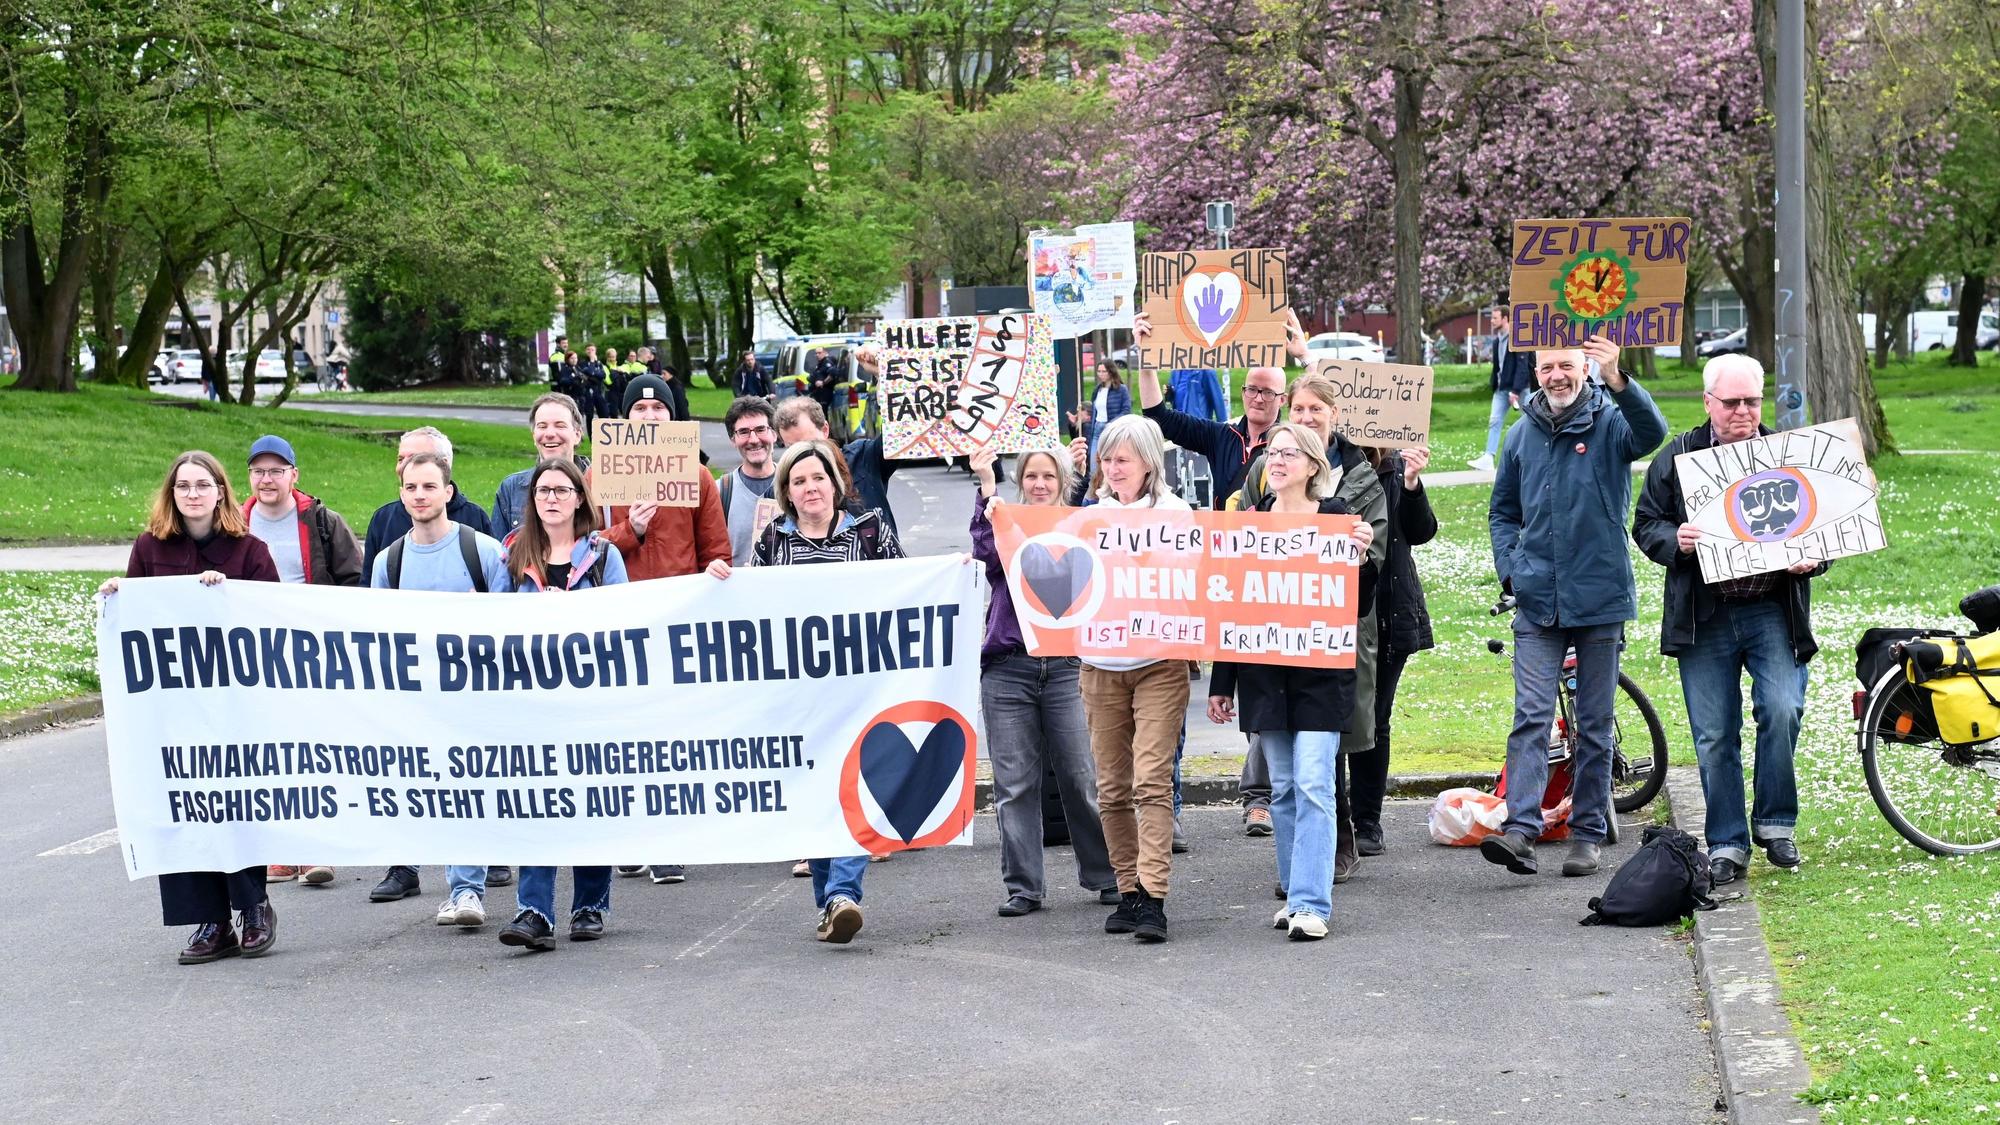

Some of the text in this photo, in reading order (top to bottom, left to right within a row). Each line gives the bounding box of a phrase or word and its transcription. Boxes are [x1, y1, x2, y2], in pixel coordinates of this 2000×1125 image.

[1514, 221, 1690, 266] ZEIT FÜR
[1144, 252, 1197, 303] HAND
[1230, 249, 1288, 314] AUFS
[886, 323, 972, 349] HILFE
[1511, 302, 1684, 348] EHRLICHKEIT
[886, 353, 969, 383] ES IST
[1140, 340, 1284, 370] EHRLICHKEIT
[1322, 365, 1425, 402] Solidarität
[887, 384, 962, 422] FARBE
[1341, 404, 1381, 416] mit der
[599, 422, 699, 449] STAAT versagt
[1333, 417, 1425, 443] tzten Generation
[600, 453, 689, 476] BESTRAFT
[1685, 428, 1865, 513] DER WAHRHEIT INS
[600, 480, 699, 502] wird der BOTE
[1098, 524, 1360, 561] ZIVILER WIDERSTAND
[1783, 506, 1887, 567] SEHEN
[1112, 566, 1346, 608] NEIN & AMEN
[120, 603, 961, 694] DEMOKRATIE BRAUCHT EHRLICHKEIT
[1087, 617, 1354, 652] IST NICHT KRIMINELL
[160, 735, 815, 782] KLIMAKATASTROPHE, SOZIALE UNGERECHTIGKEIT,
[167, 785, 338, 824] FASCHISMUS
[366, 786, 399, 817] ES
[408, 788, 486, 819] STEHT
[496, 786, 577, 819] ALLES
[586, 785, 636, 818] AUF
[645, 782, 707, 816] DEM
[714, 780, 788, 815] SPIEL
